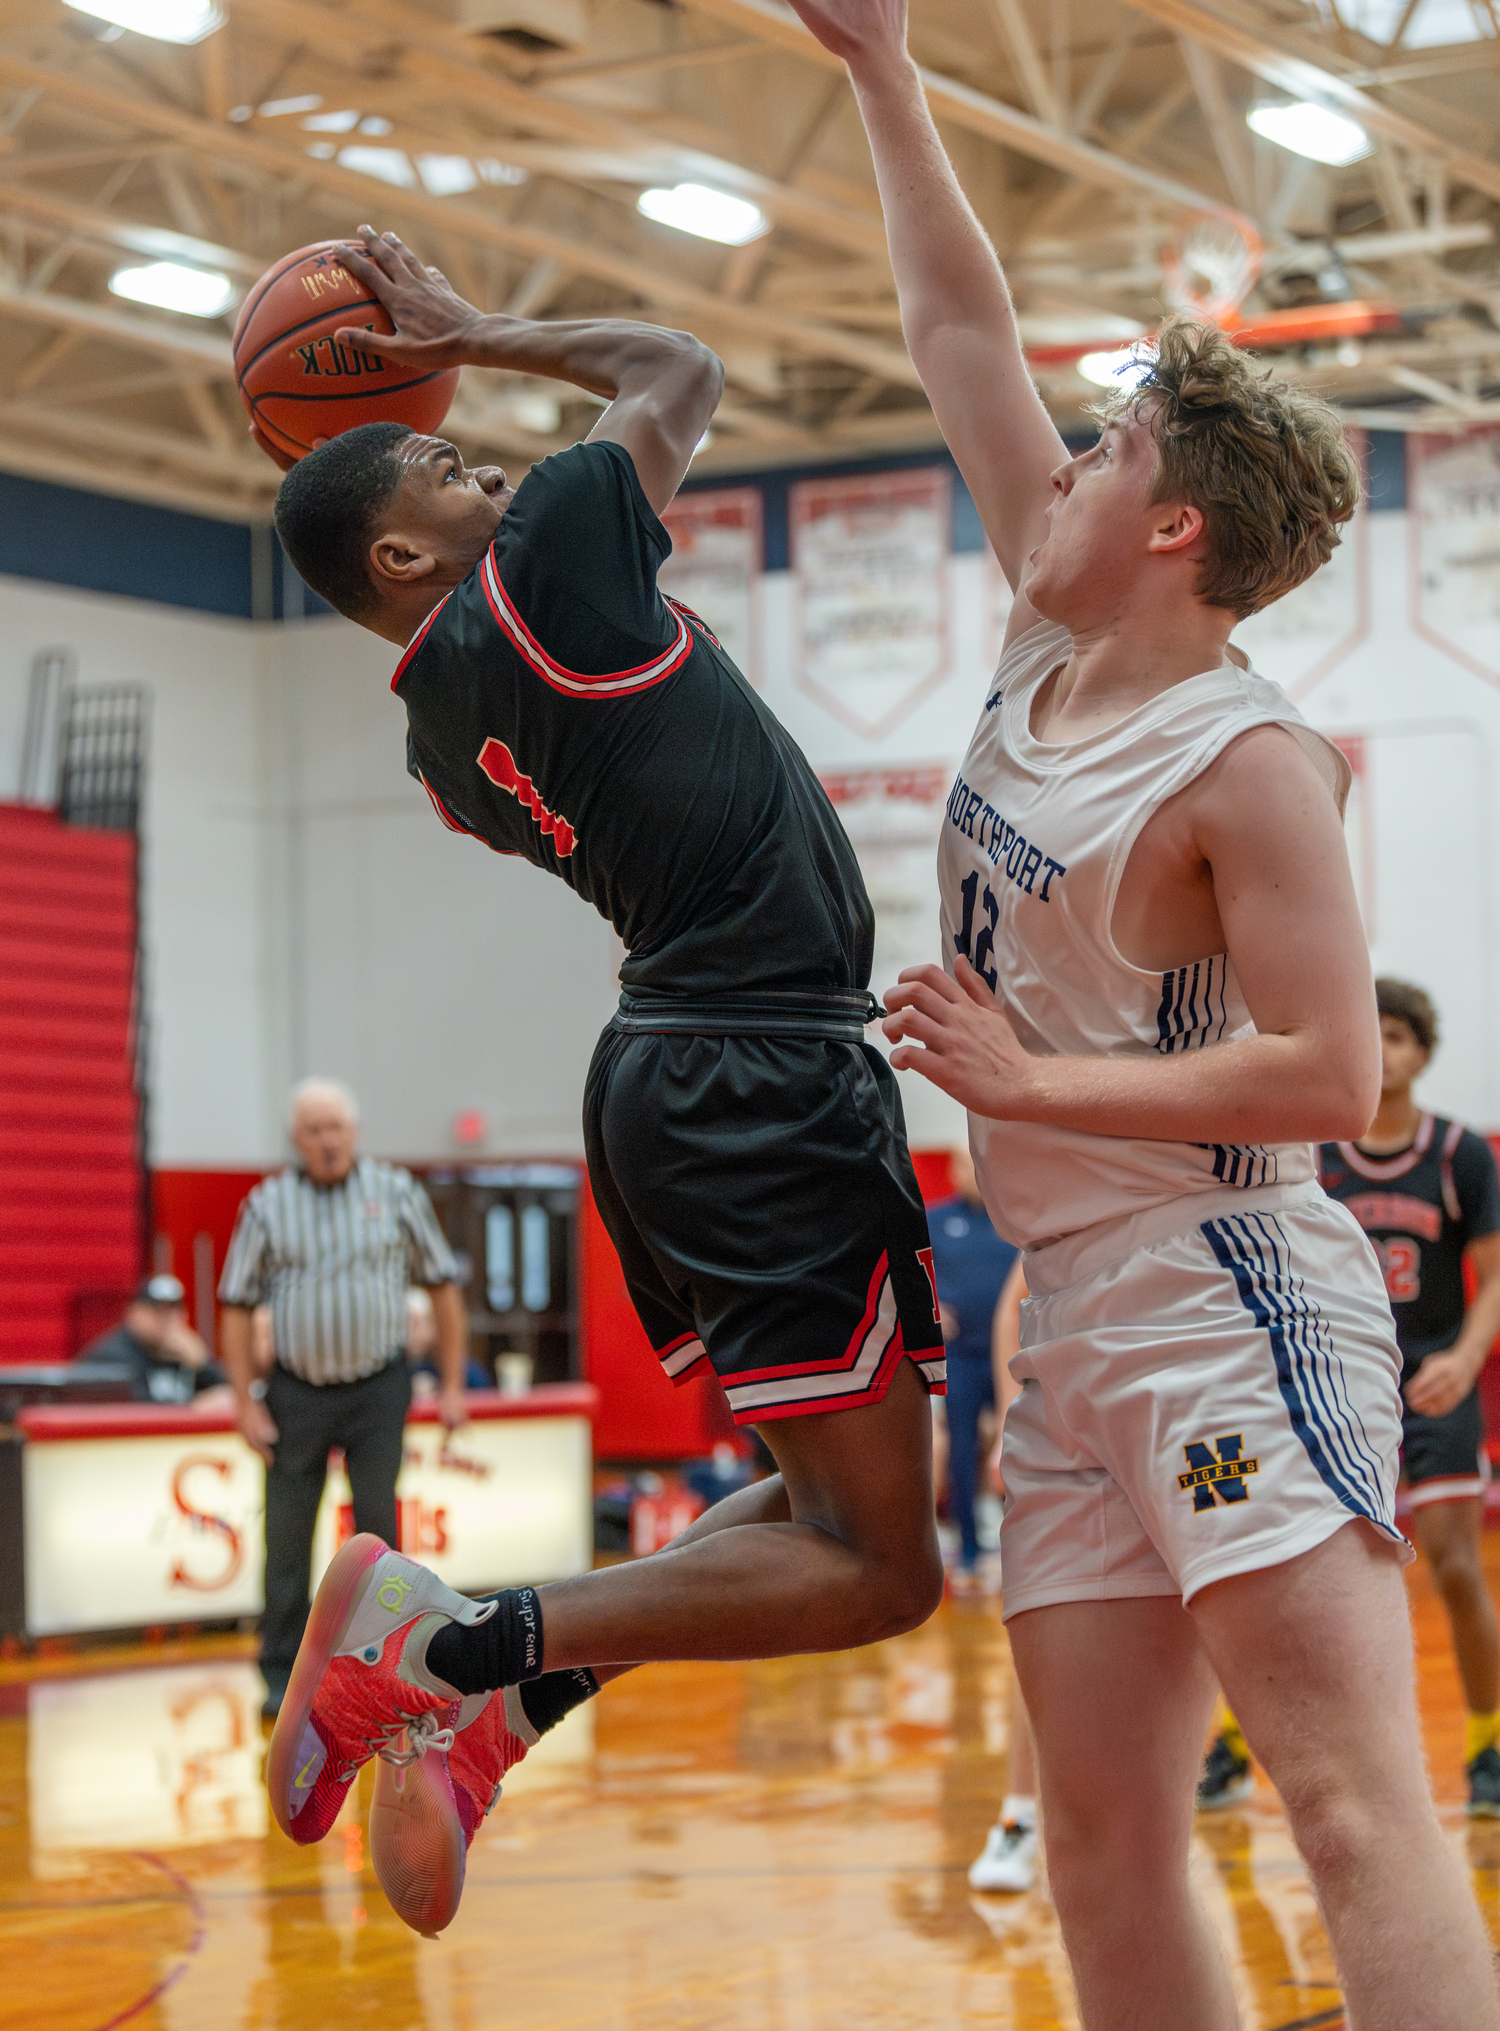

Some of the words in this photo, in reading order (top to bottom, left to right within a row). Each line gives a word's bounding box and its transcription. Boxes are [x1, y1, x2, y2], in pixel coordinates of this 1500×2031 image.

[946, 772, 1067, 903] NORTHPORT
[953, 869, 999, 995] 12
[1180, 1461, 1256, 1486] TIGERS
[518, 1589, 536, 1668] Supreme
